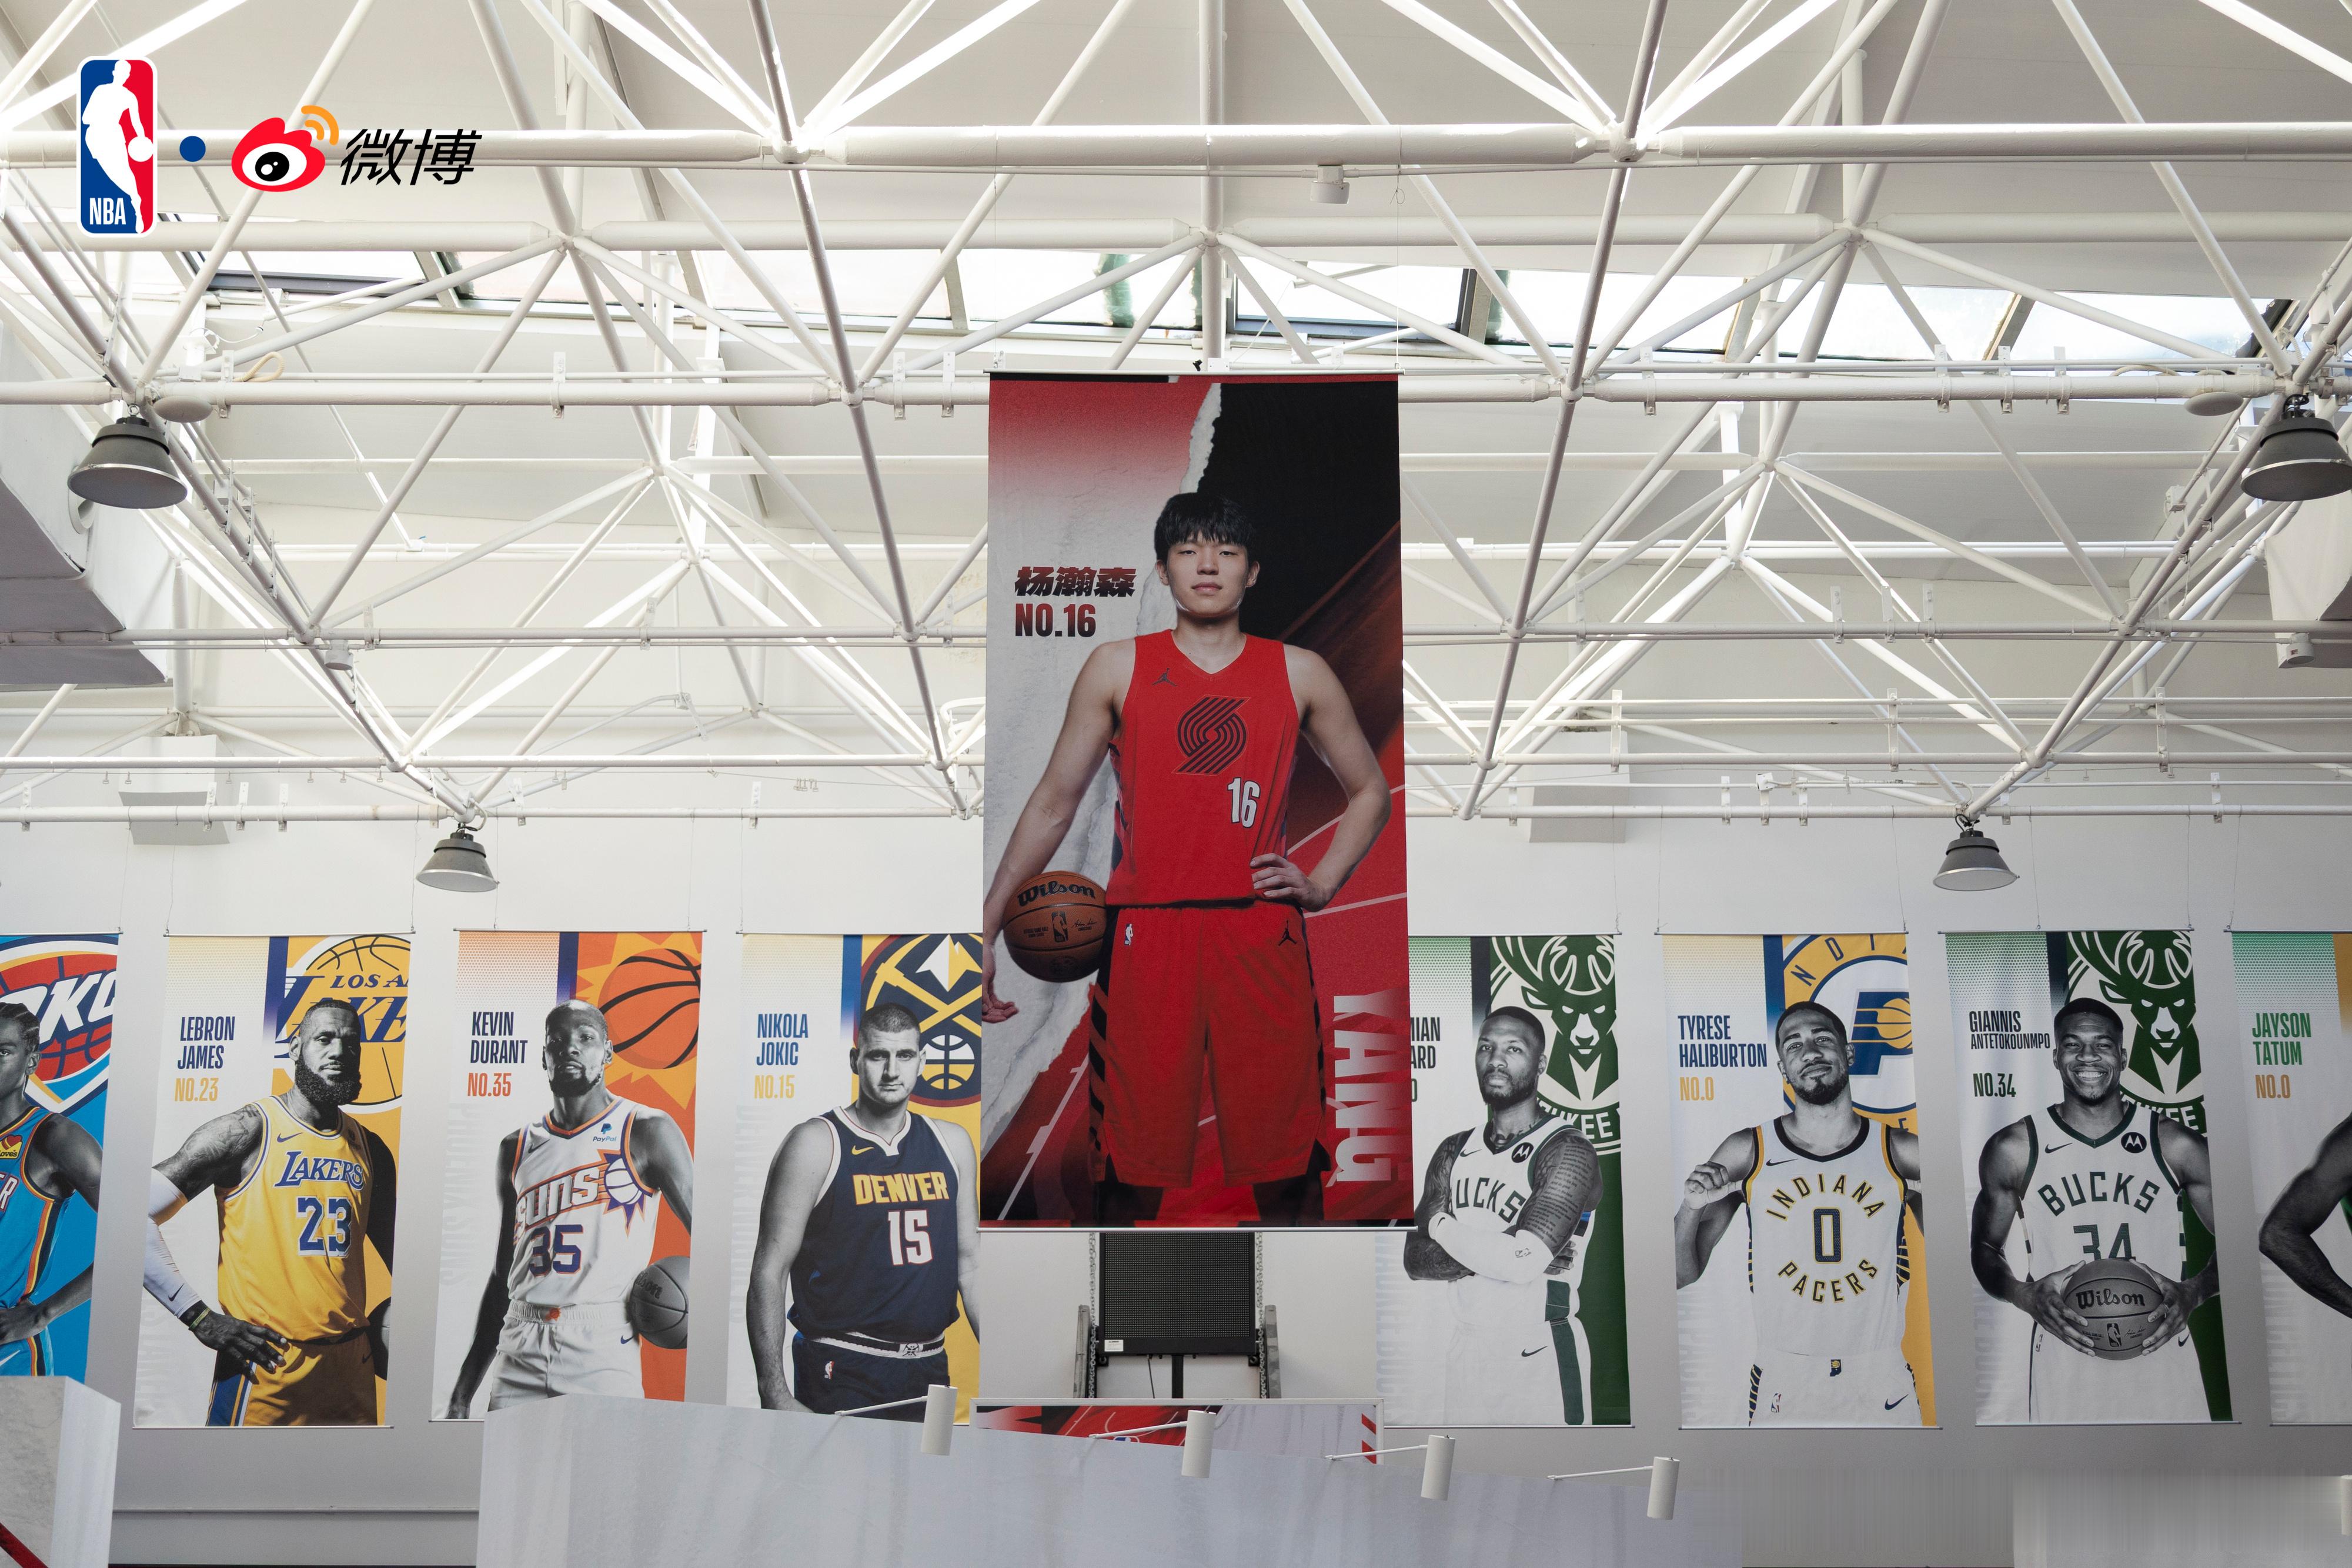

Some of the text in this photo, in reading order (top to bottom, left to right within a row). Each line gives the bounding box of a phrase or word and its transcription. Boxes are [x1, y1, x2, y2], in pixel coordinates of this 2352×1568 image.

[1015, 566, 1137, 597] 杨瀚森
[1015, 603, 1096, 637] NO.16
[1227, 777, 1261, 828] 16
[1017, 881, 1095, 907] Wilson
[330, 974, 380, 988] LOS
[180, 1016, 235, 1041] LEBRON
[472, 1012, 514, 1037] KEVIN
[757, 1014, 808, 1038] NIKOLA
[1678, 1015, 1731, 1040] TYRESE
[1969, 1011, 2022, 1032] GIANNIS
[2253, 1012, 2311, 1038] JAYSON
[470, 1040, 528, 1064] DURANT
[1971, 1033, 2050, 1049] ANTETOKOUNMPO
[2253, 1041, 2302, 1065] TATUM
[177, 1045, 224, 1069] JAMES
[756, 1042, 799, 1066] JOKIC
[1679, 1043, 1768, 1068] HALIBURTON
[175, 1078, 218, 1102] NO.23
[467, 1073, 512, 1097] NO.35
[754, 1075, 794, 1099] NO.15
[1334, 988, 1410, 1181] YANG
[1680, 1077, 1713, 1101] NO.0
[1973, 1072, 2016, 1098] NO.34
[2255, 1075, 2290, 1098] NO.0
[273, 1150, 364, 1192] LAKERS
[853, 1171, 950, 1205] DENVER
[1765, 1172, 1886, 1221] INDIANA
[2037, 1172, 2160, 1216] BUCKS
[296, 1195, 352, 1259] 23
[887, 1209, 933, 1266] 15
[1813, 1207, 1842, 1265] 0
[529, 1224, 584, 1278] 35
[2073, 1223, 2136, 1261] 34
[1778, 1258, 1878, 1303] PACERS
[2076, 1289, 2145, 1310] Wilson
